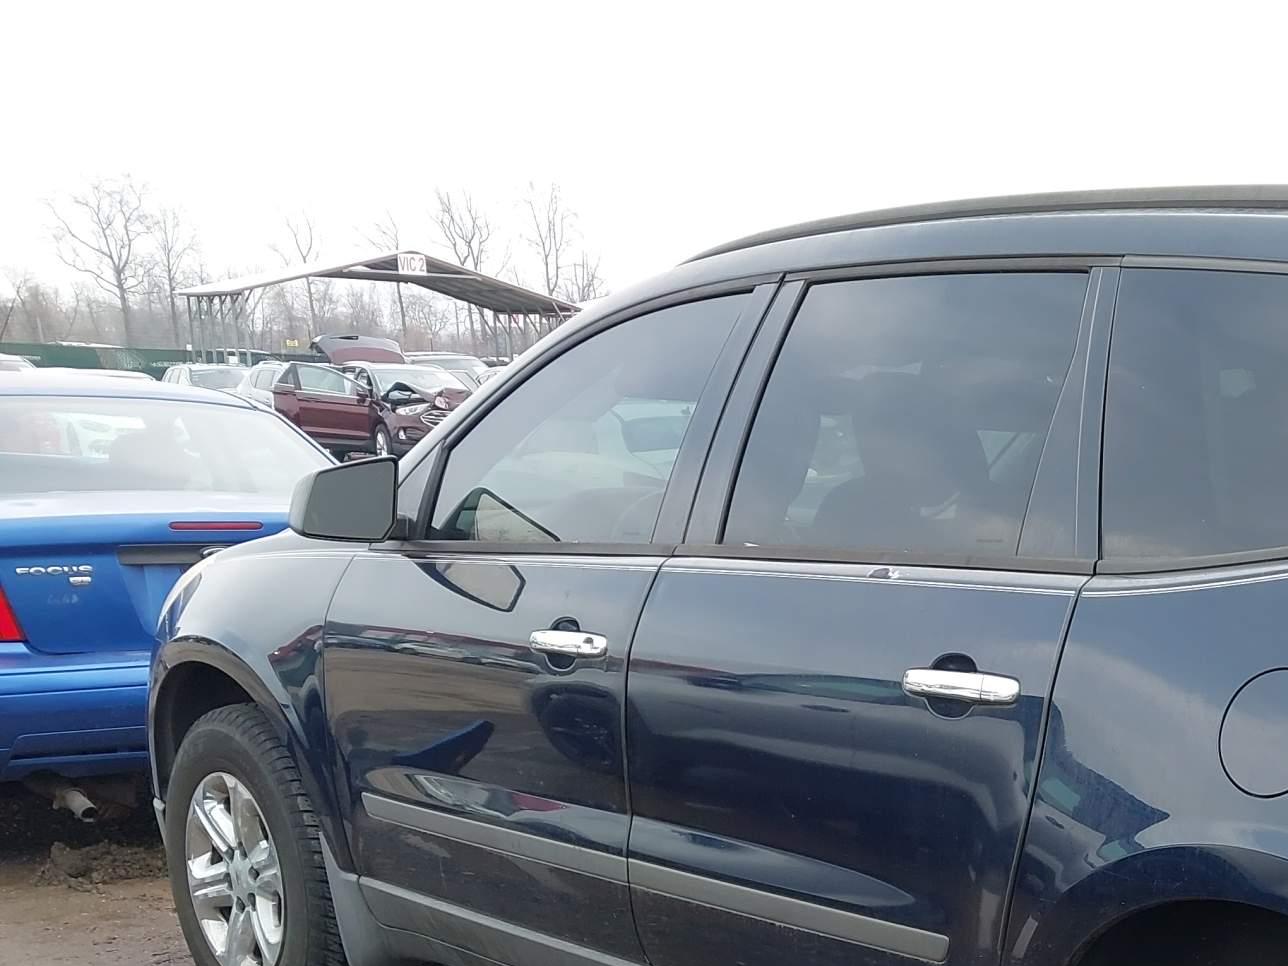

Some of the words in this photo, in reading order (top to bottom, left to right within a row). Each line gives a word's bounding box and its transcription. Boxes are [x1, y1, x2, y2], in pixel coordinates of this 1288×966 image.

[399, 256, 416, 272] VIC
[419, 257, 425, 272] 2
[15, 565, 93, 576] FOCUS
